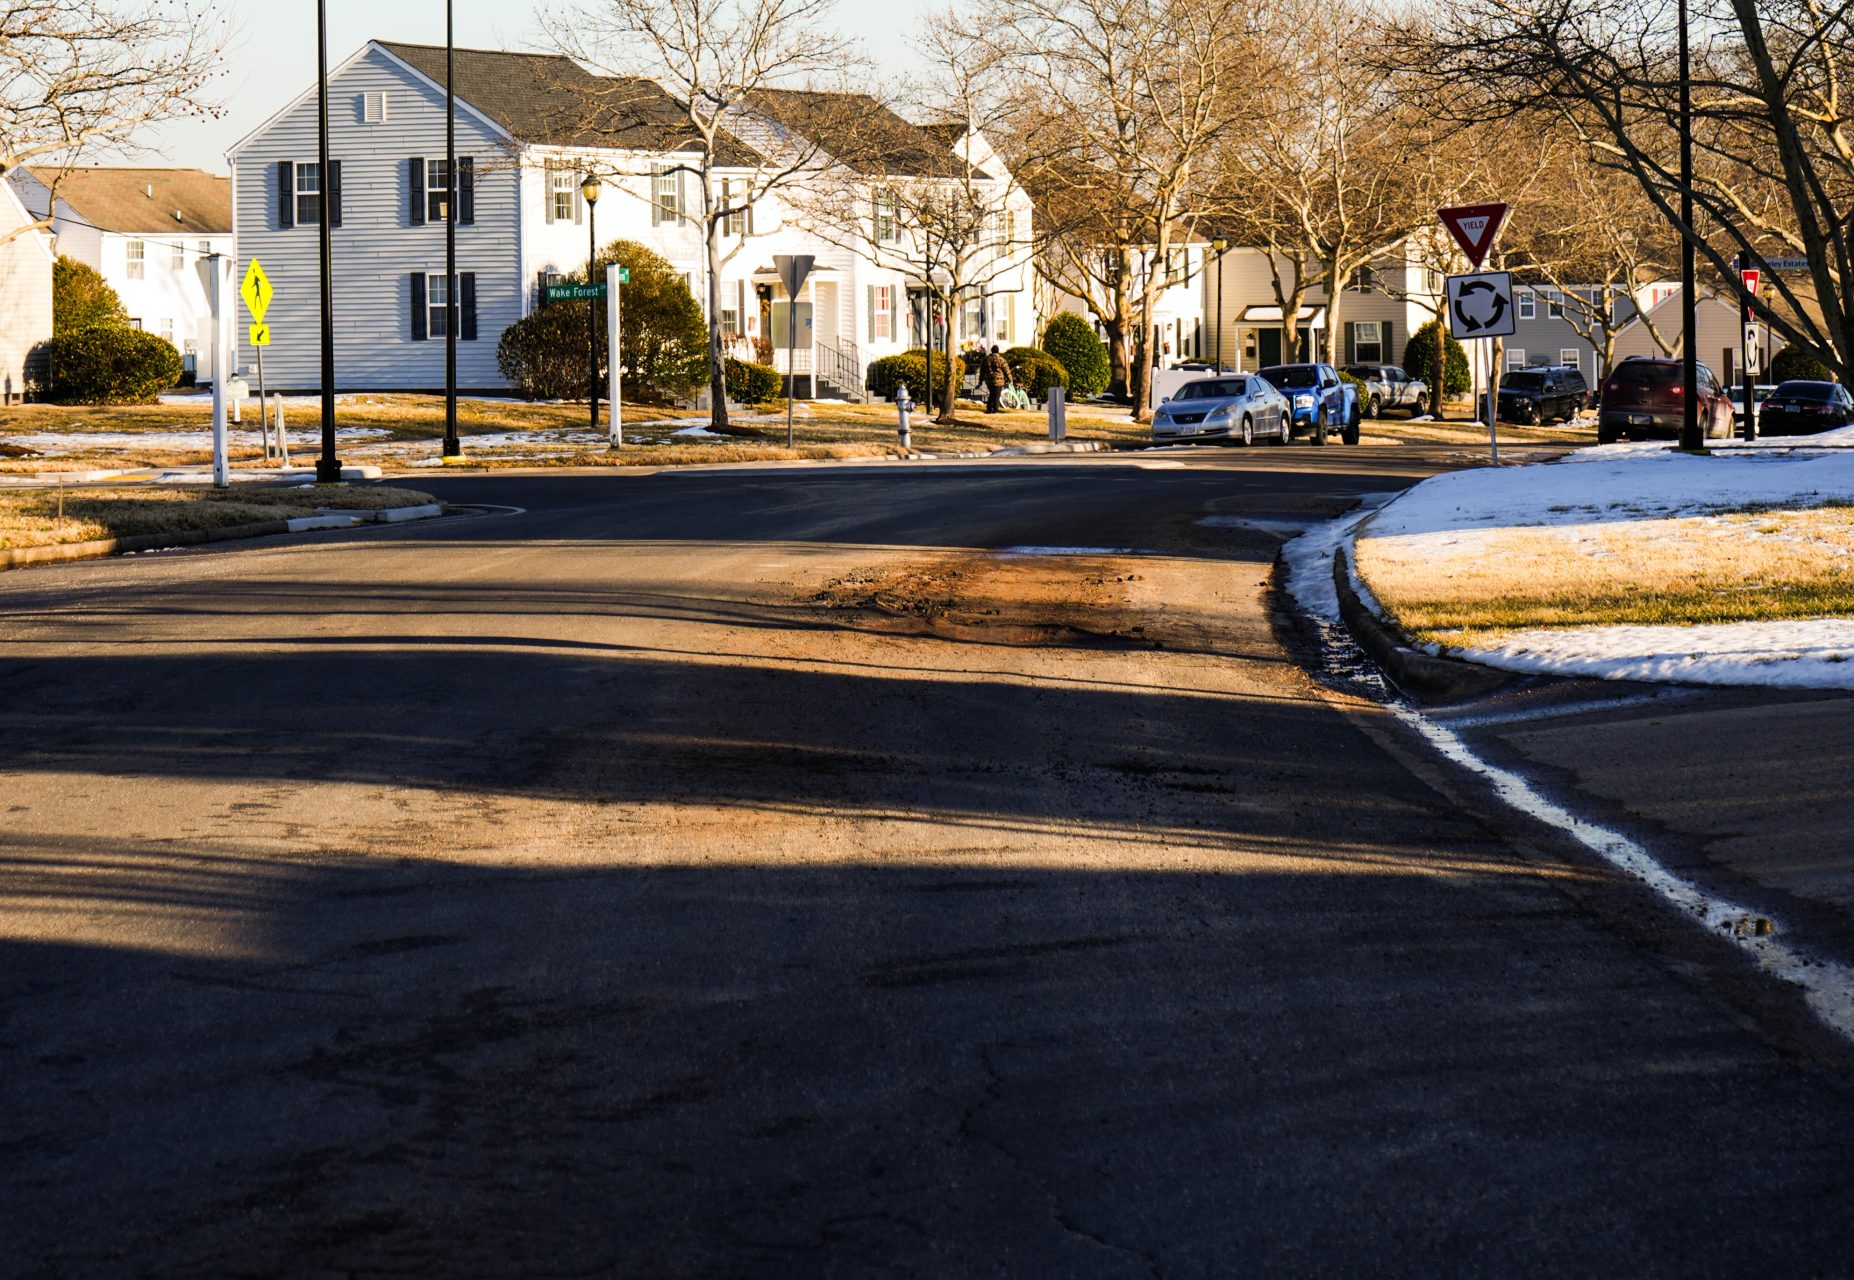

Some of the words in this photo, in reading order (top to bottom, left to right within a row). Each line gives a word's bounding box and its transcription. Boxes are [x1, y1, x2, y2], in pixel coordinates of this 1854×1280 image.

[1463, 221, 1484, 230] YIELD
[549, 288, 570, 298] Wake
[573, 287, 599, 297] Forest
